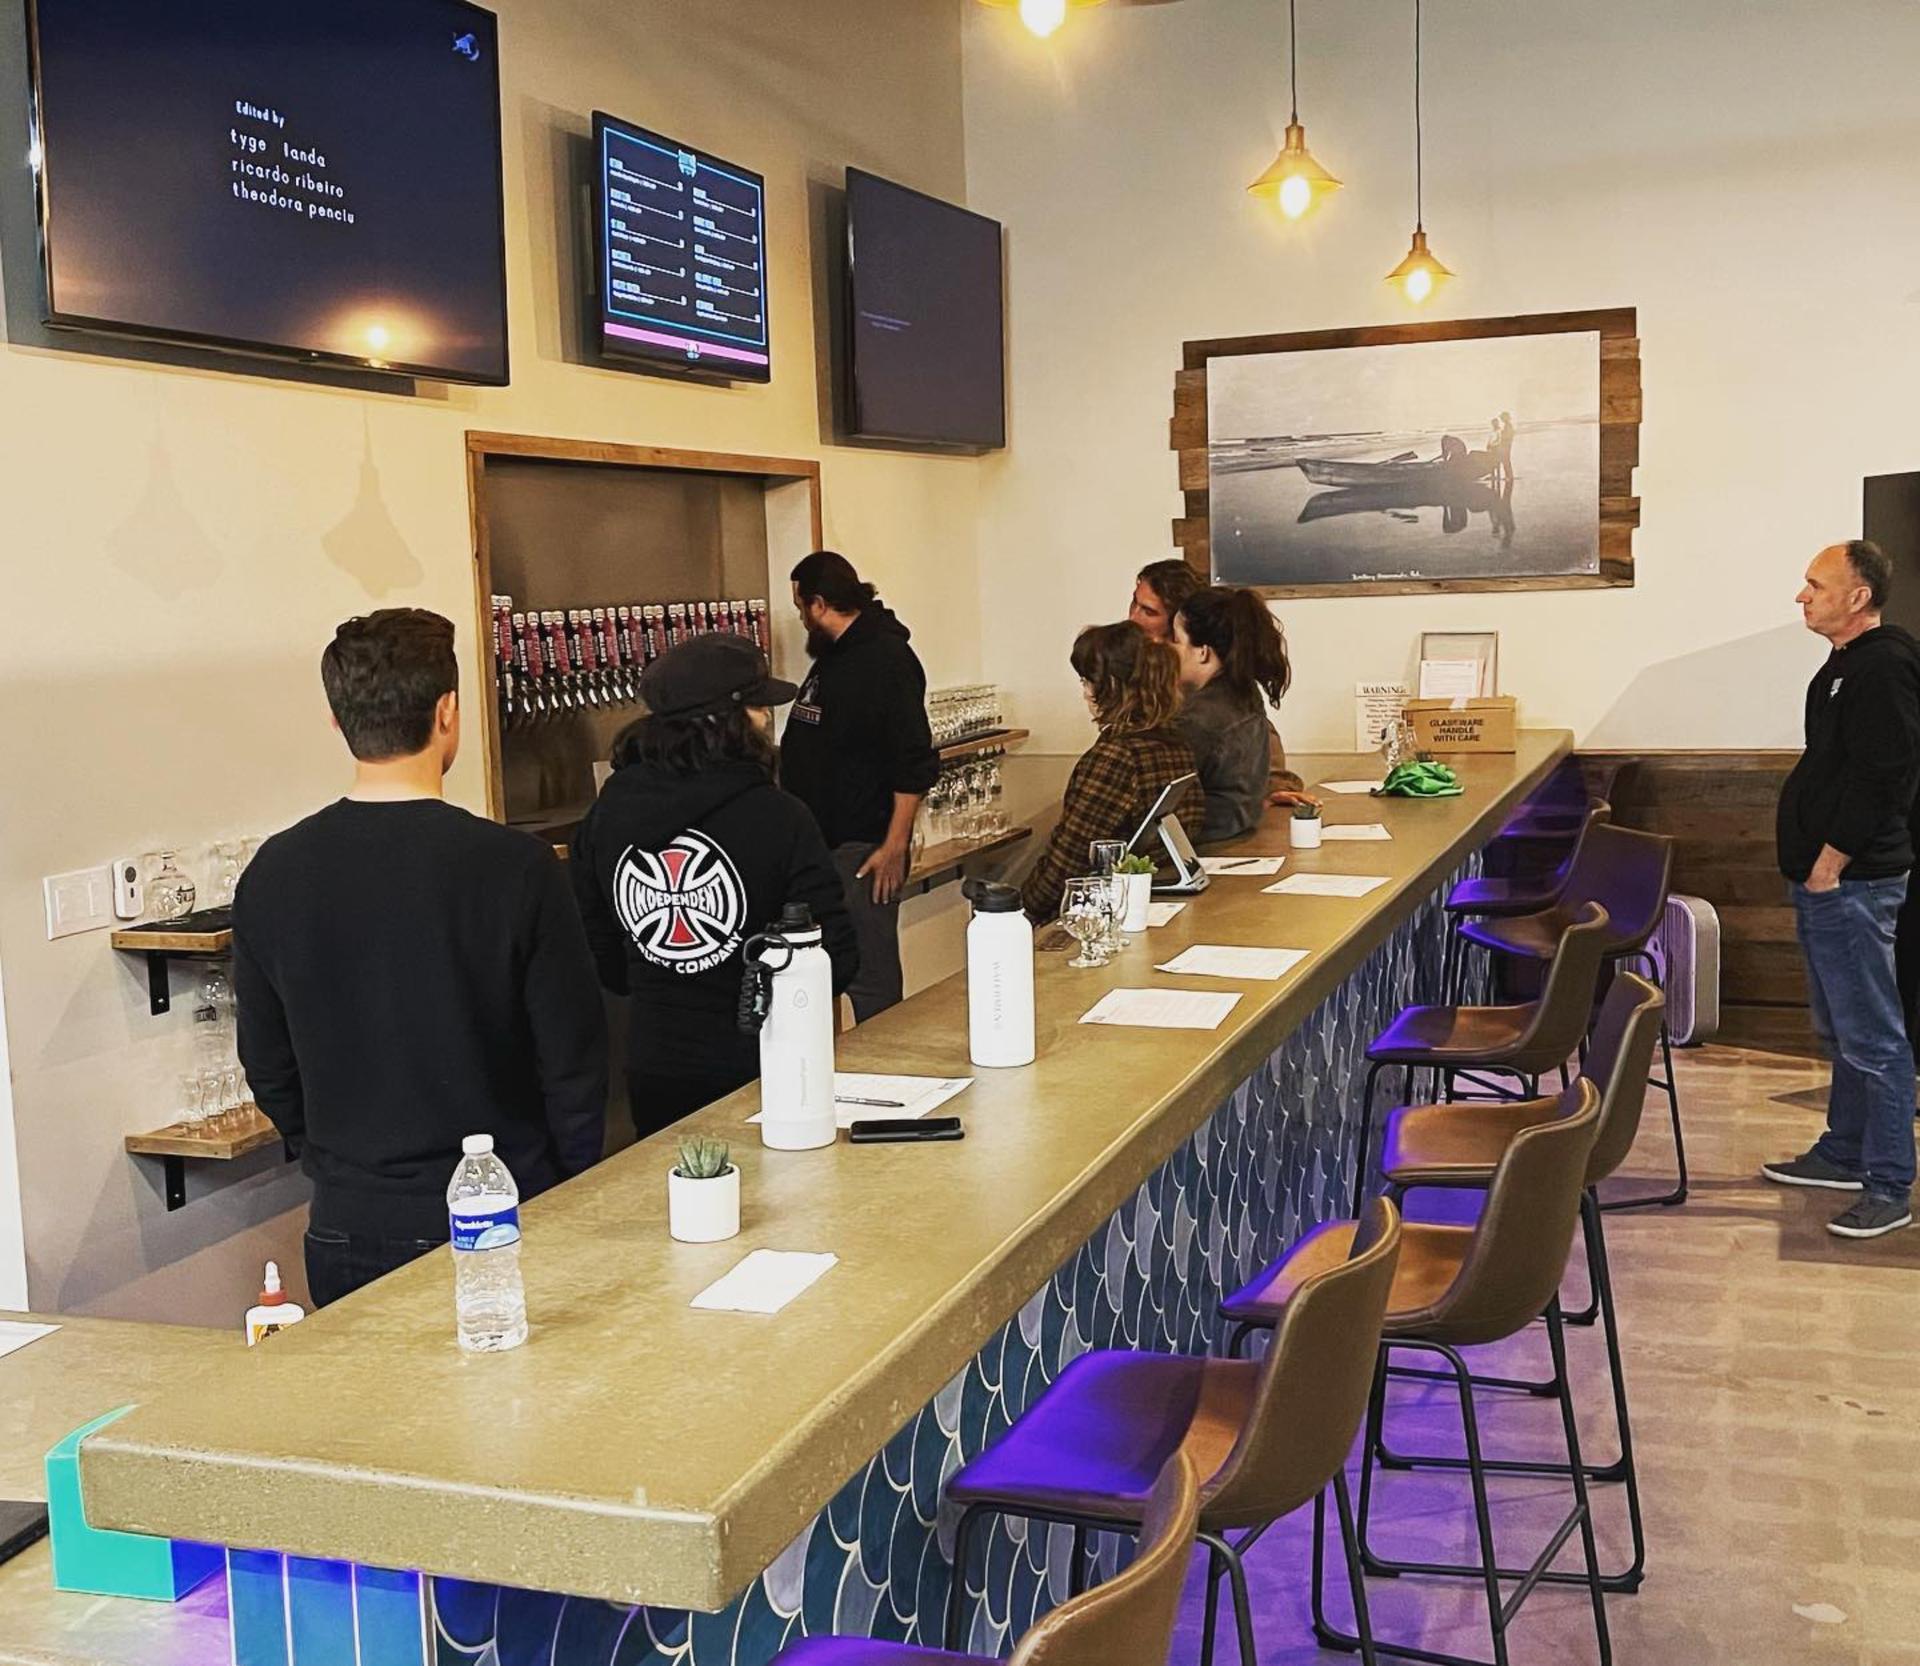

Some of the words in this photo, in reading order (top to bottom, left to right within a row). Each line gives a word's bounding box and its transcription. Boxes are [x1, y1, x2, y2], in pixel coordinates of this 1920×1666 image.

[236, 101, 269, 121] Edited
[272, 110, 285, 128] by
[230, 128, 266, 153] tyge
[283, 142, 326, 167] landa
[232, 159, 290, 184] ricardo
[295, 173, 344, 198] ribeiro
[232, 181, 303, 212] theodora
[309, 203, 355, 224] penciu
[1432, 734, 1456, 742] WITH
[628, 876, 724, 921] INDEPENDENT
[675, 931, 743, 974] COMPANY
